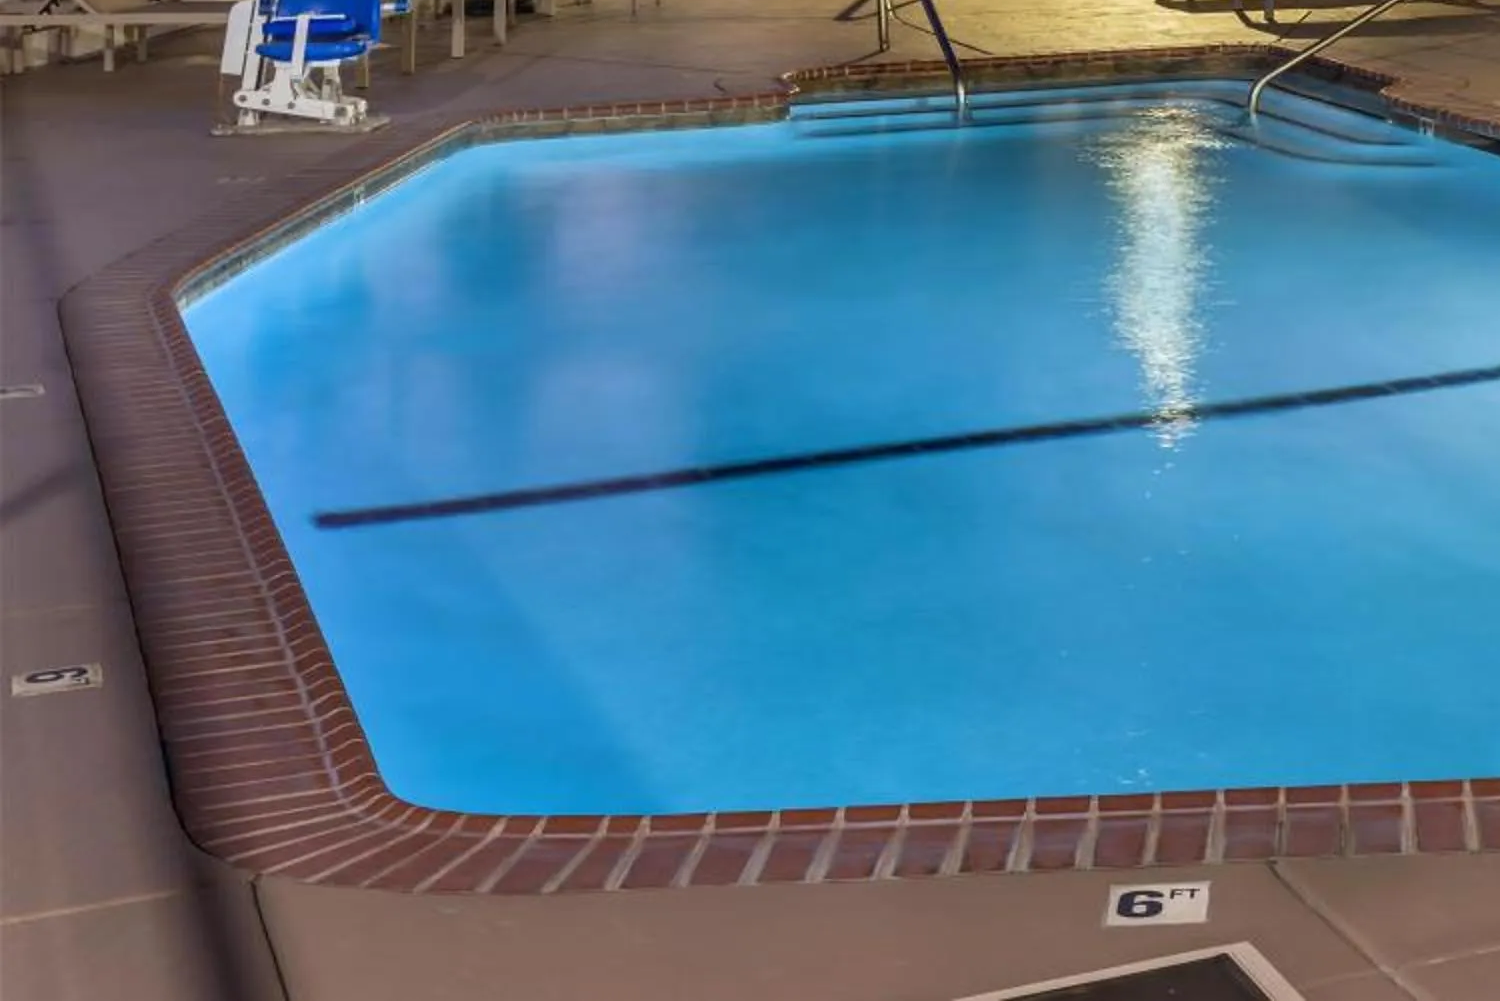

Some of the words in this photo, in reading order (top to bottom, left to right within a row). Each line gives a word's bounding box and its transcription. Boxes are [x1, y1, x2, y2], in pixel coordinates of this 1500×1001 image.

[24, 666, 89, 684] 6
[1117, 890, 1165, 918] 6
[1169, 888, 1201, 900] FT
